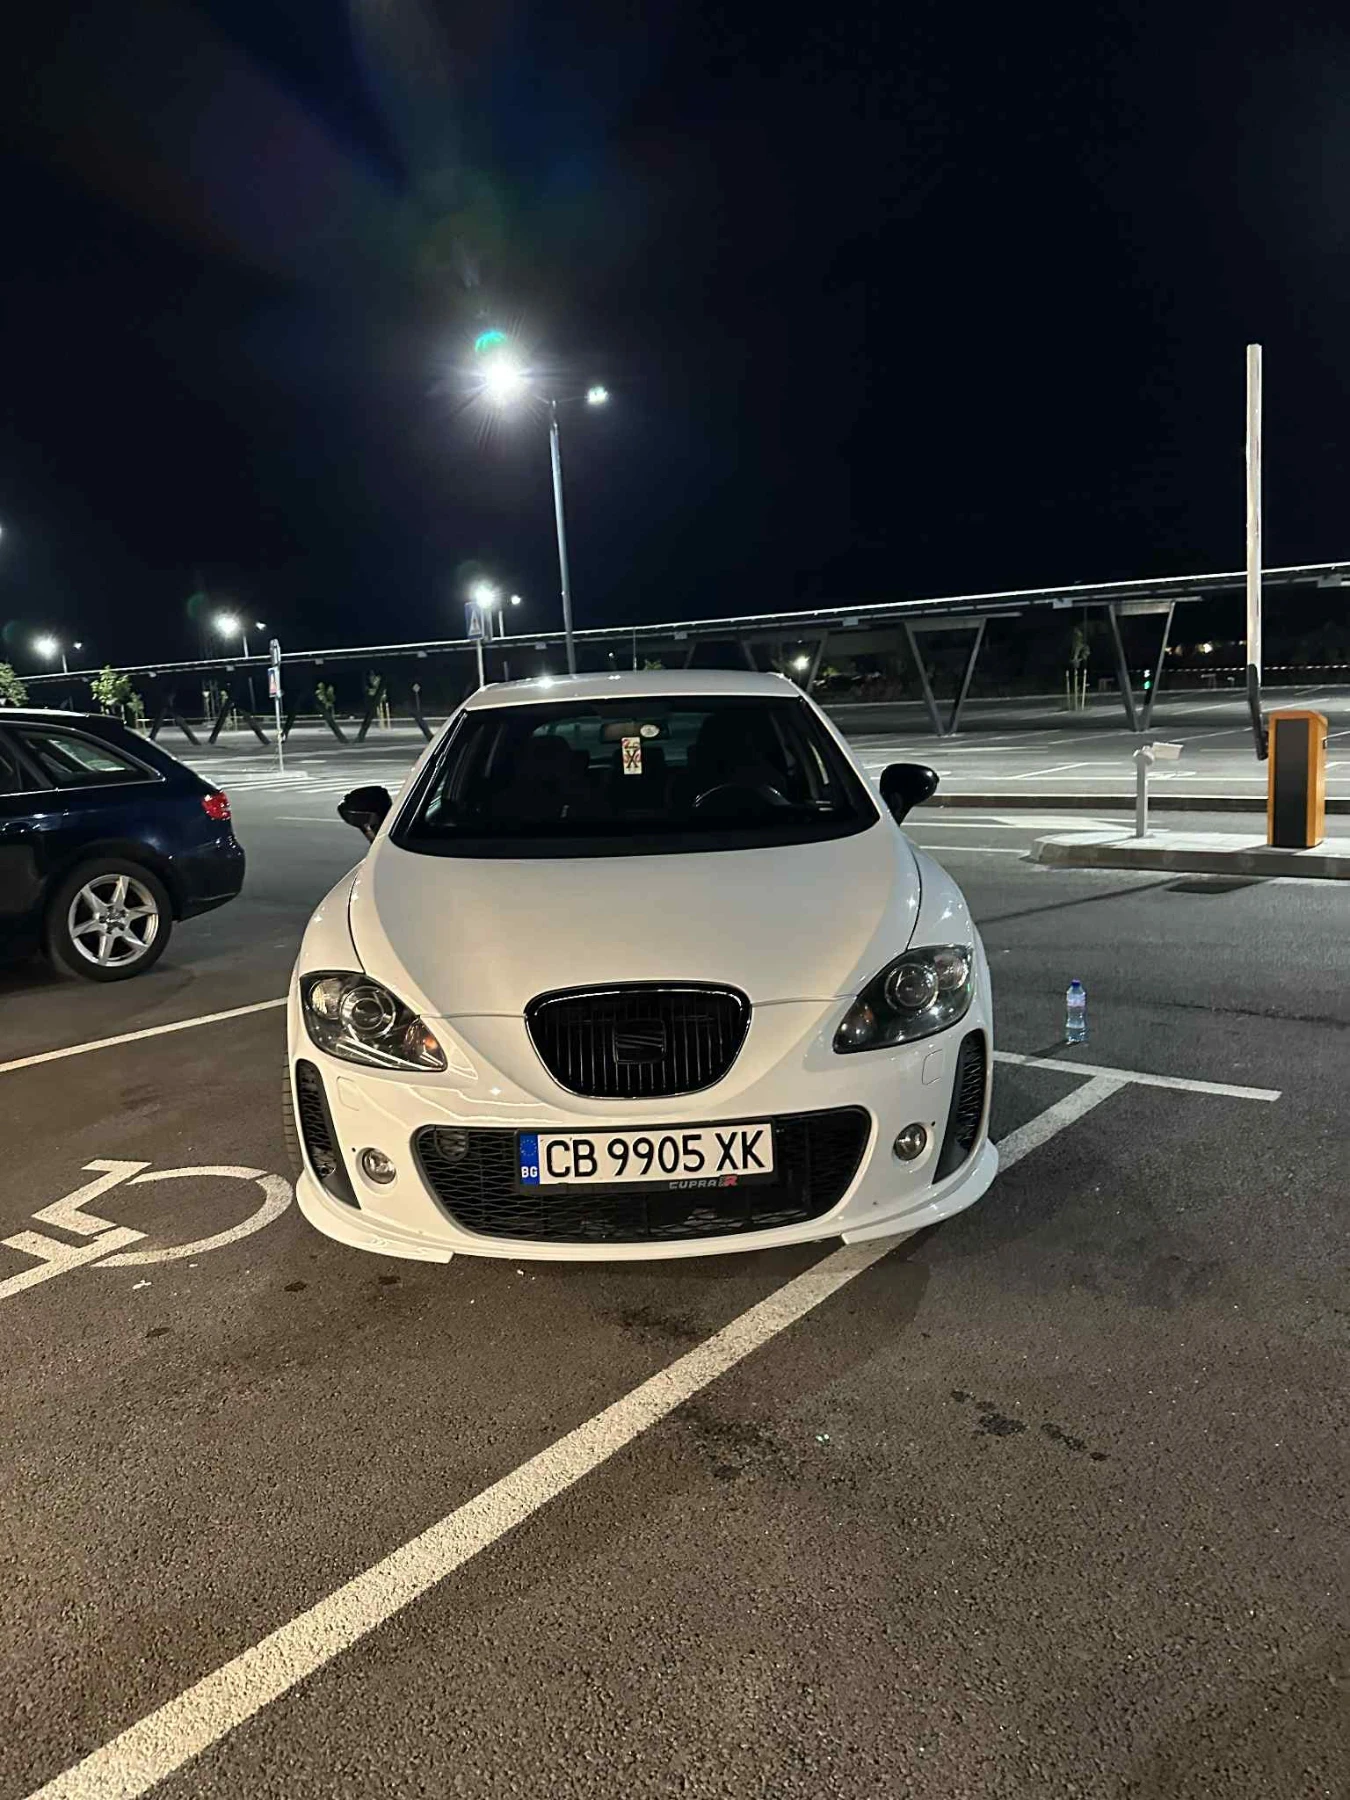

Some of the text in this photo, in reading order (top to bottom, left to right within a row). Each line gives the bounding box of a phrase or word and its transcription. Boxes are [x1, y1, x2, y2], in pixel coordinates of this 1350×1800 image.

[546, 1130, 766, 1178] CB 9905 XK
[521, 1165, 538, 1178] BG
